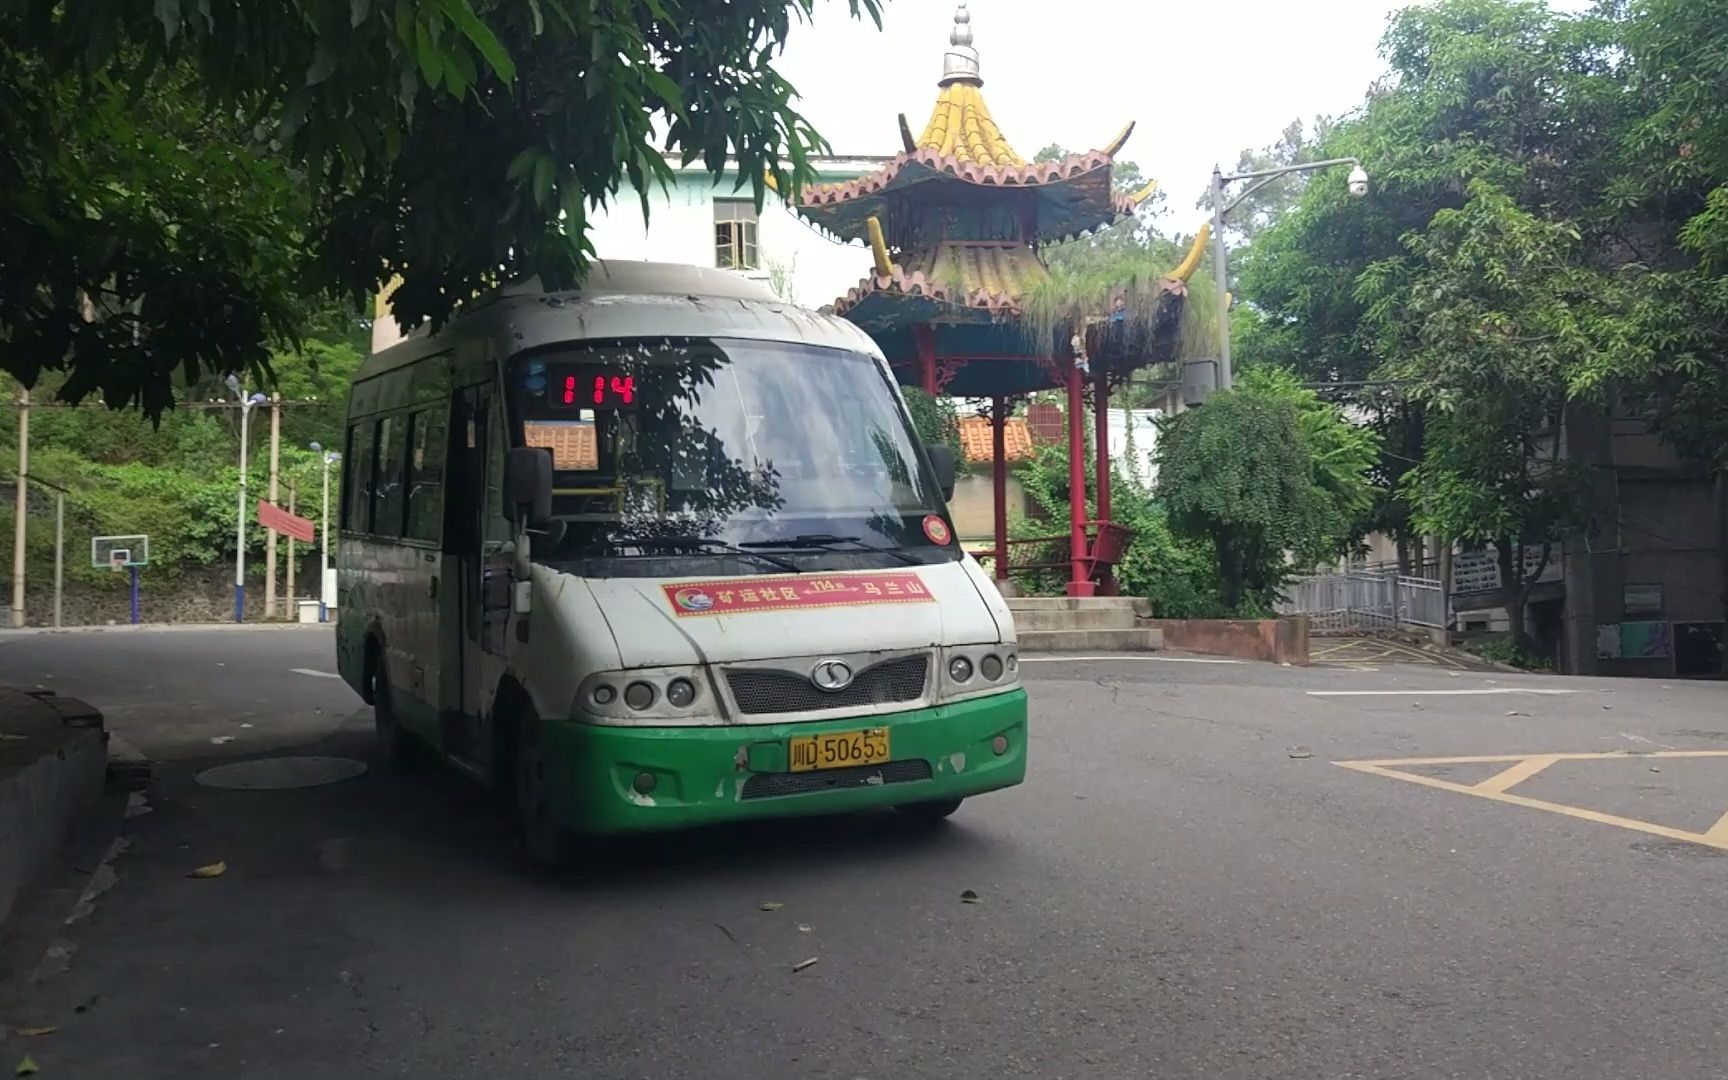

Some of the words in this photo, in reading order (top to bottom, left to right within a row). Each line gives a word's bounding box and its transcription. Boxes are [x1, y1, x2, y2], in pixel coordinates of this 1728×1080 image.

[564, 376, 633, 404] 114
[862, 582, 925, 595] 马兰山
